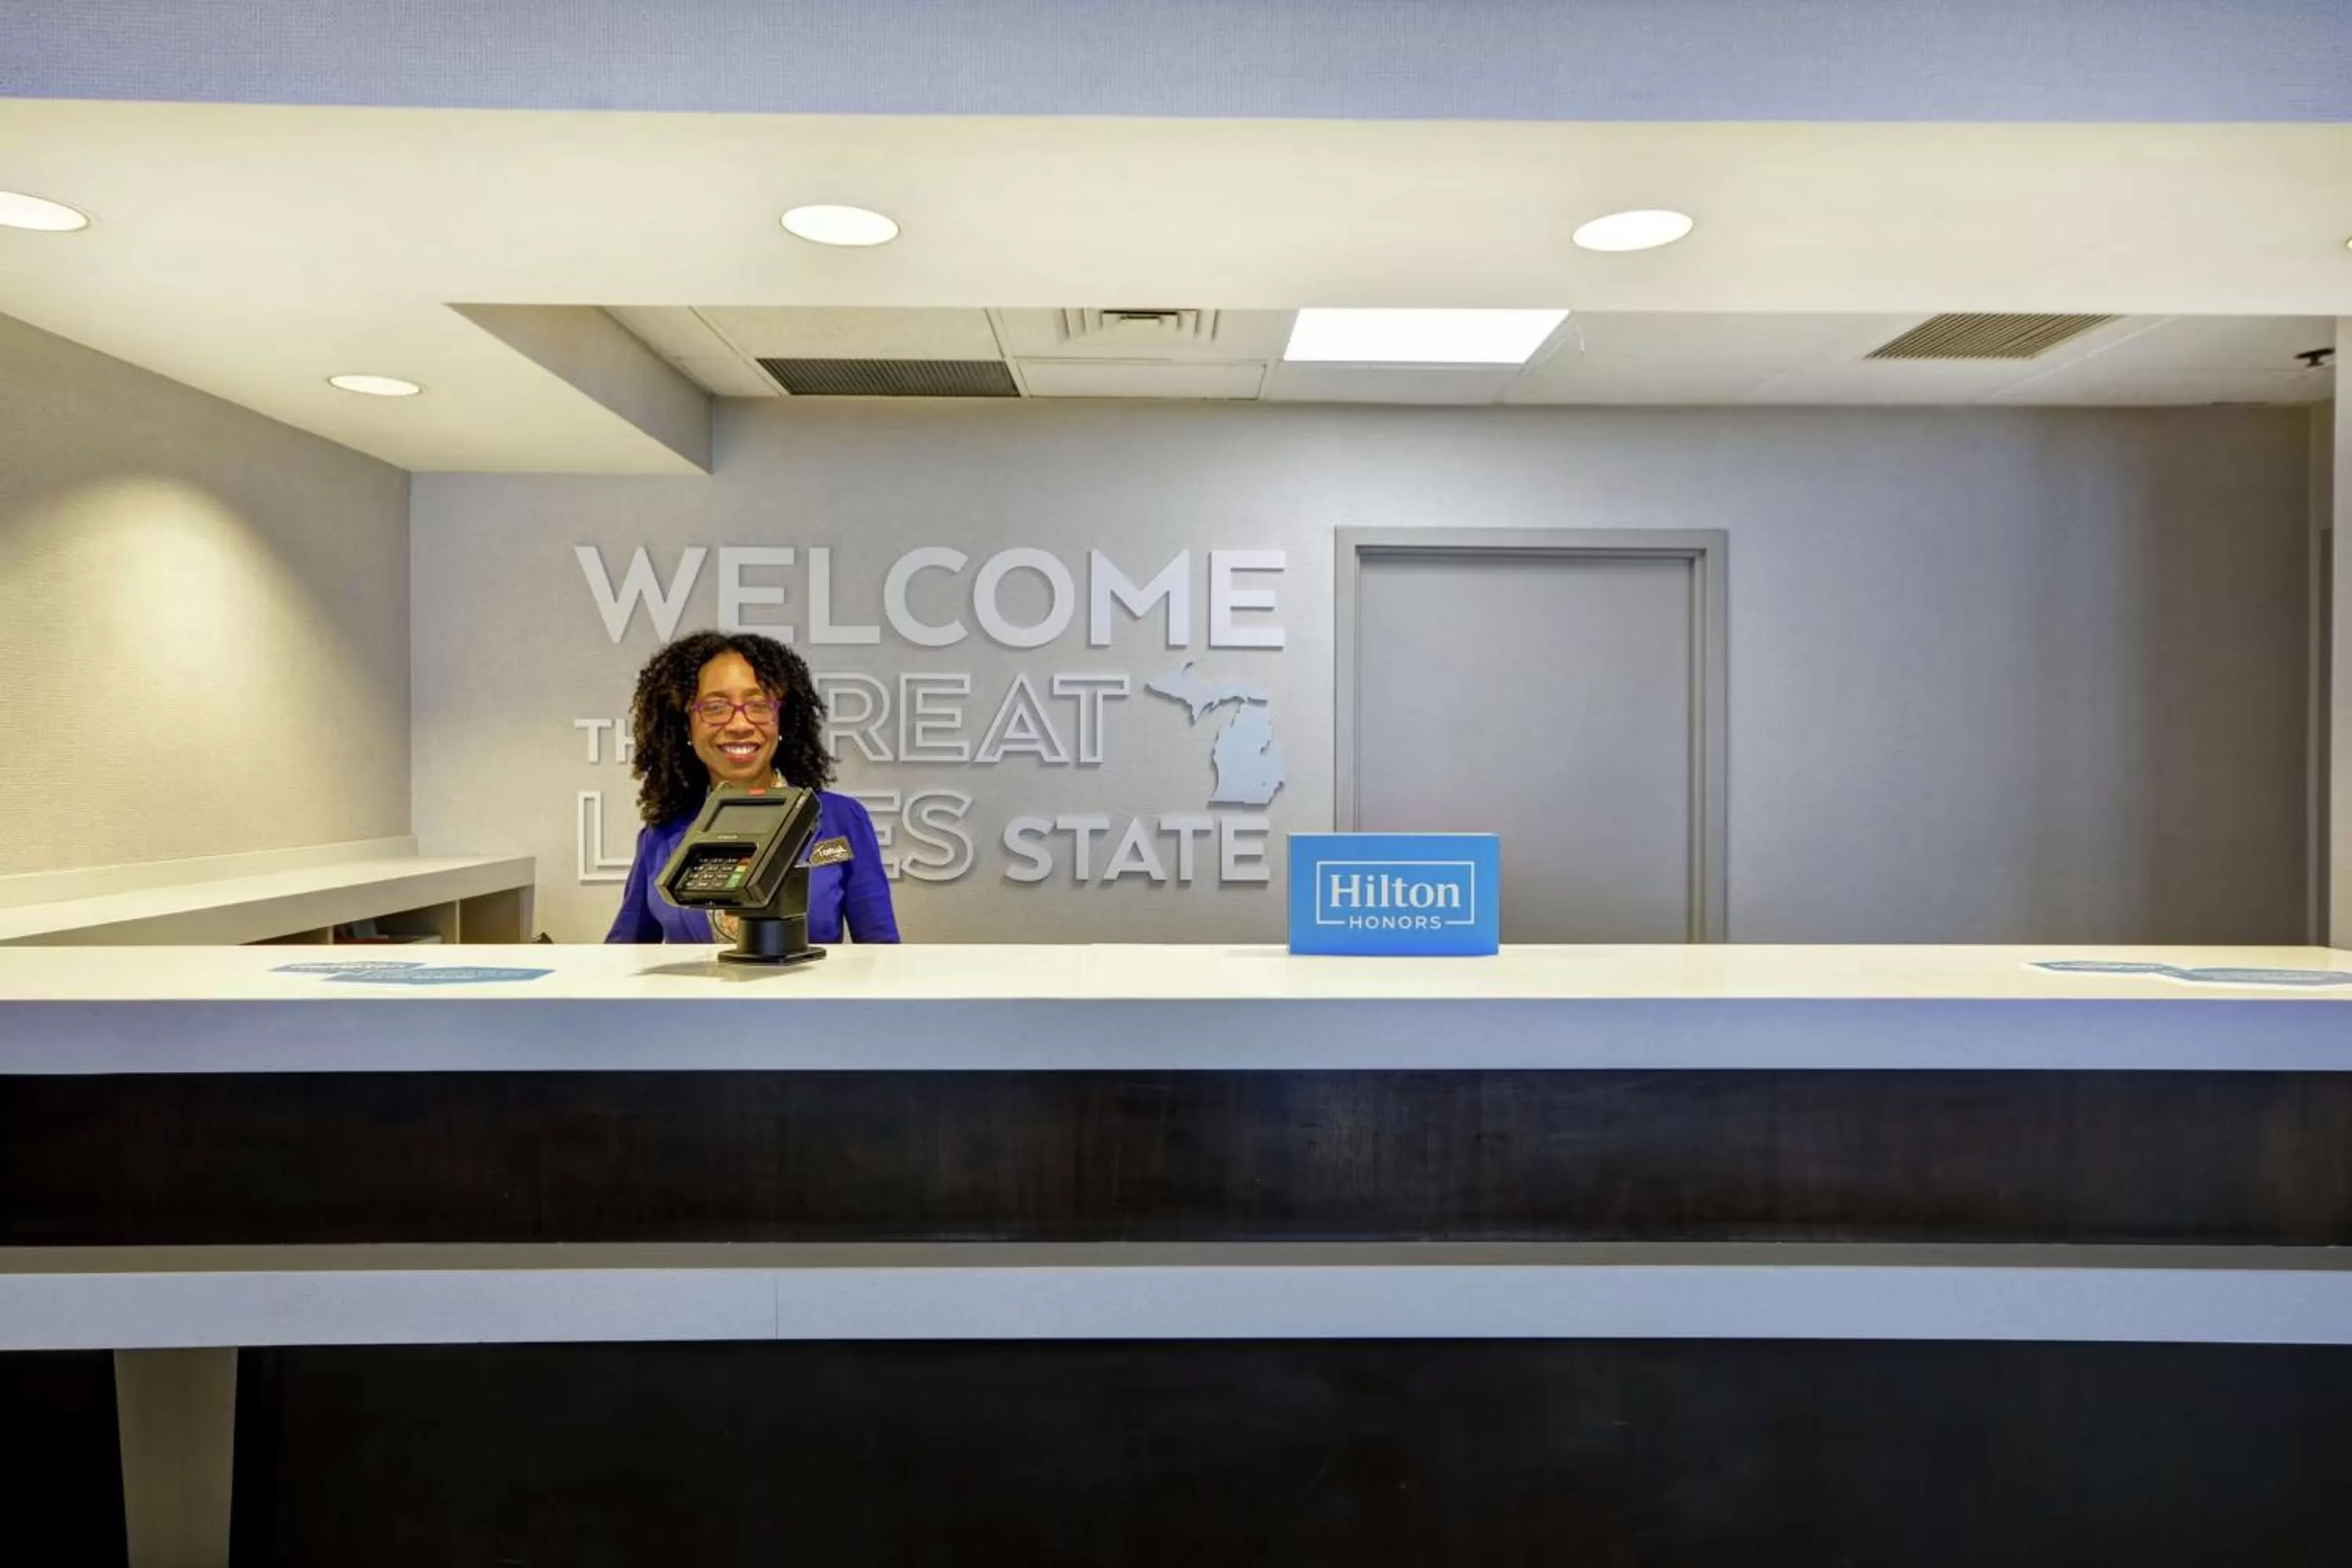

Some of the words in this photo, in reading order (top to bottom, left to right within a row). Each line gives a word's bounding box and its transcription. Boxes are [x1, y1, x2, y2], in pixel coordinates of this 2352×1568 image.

[574, 546, 1286, 648] WELCOME
[574, 718, 634, 762] TH
[812, 673, 1129, 763] REAT
[1004, 816, 1269, 883] STATE
[1330, 874, 1461, 908] Hilton
[1348, 916, 1443, 929] HONORS
